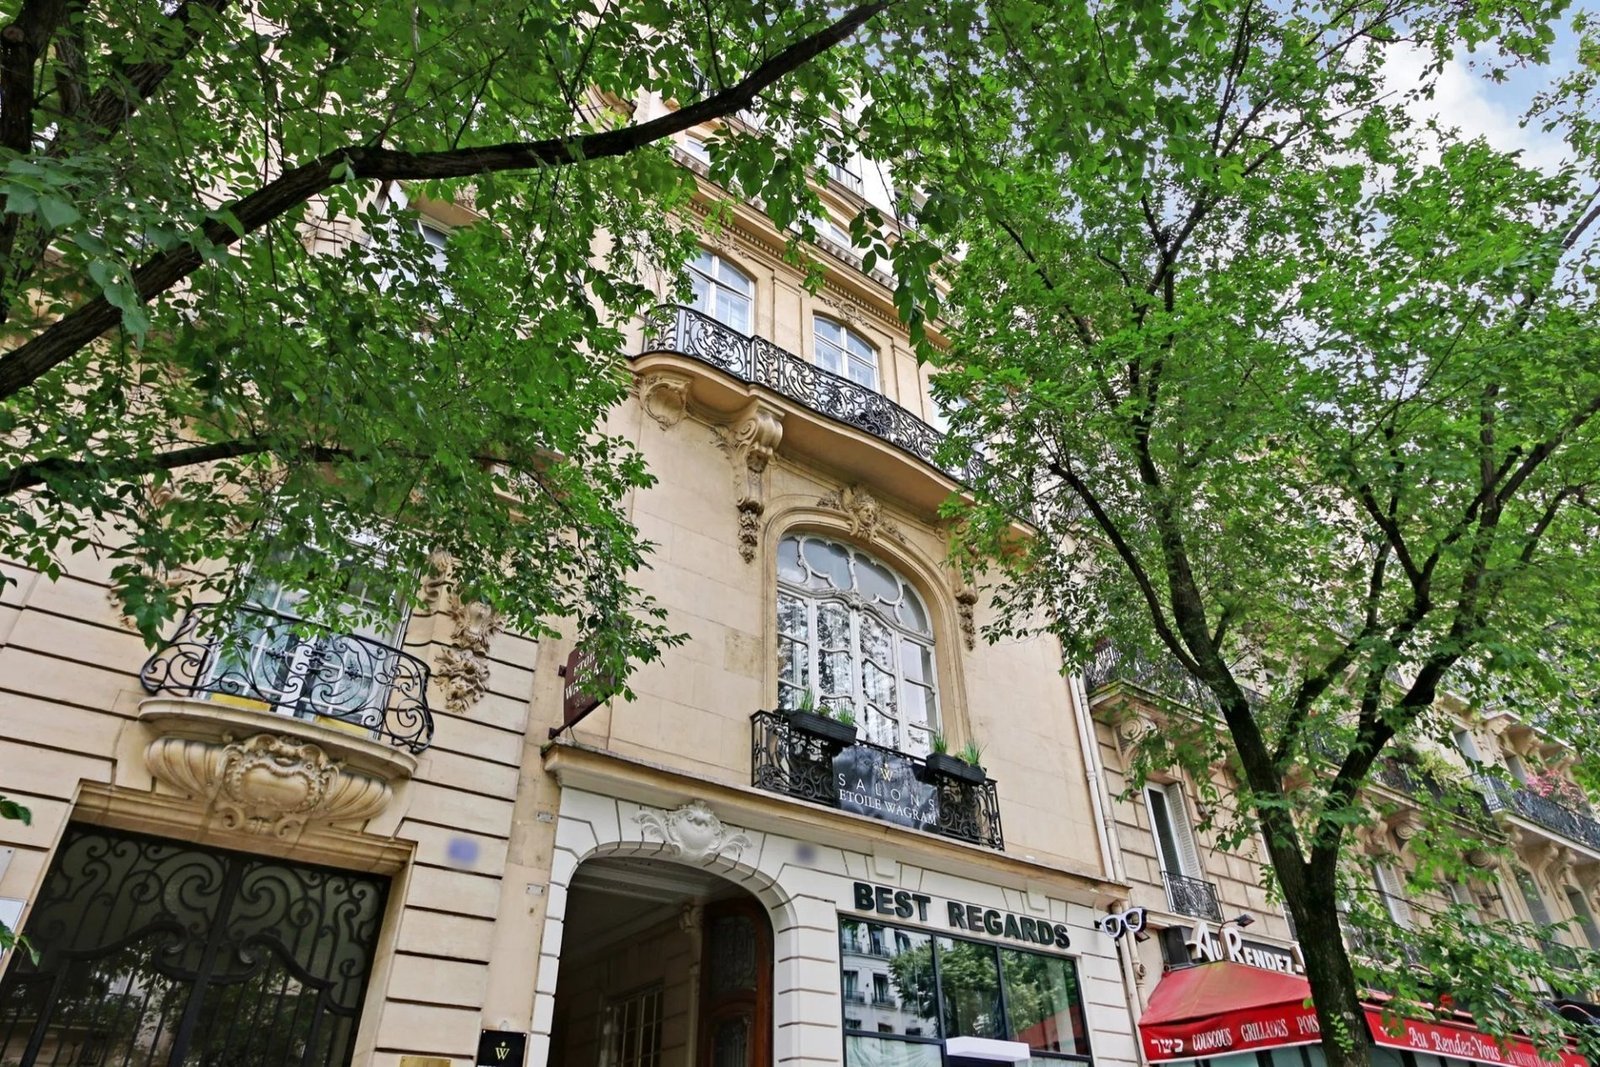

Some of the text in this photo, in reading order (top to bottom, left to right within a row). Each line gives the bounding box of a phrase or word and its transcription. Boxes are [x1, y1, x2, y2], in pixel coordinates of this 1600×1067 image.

[879, 767, 893, 782] W
[838, 773, 935, 811] SALONS
[839, 788, 937, 826] ETOILE WAGRAM
[853, 881, 1071, 949] BEST REGARDS
[1150, 1038, 1184, 1054] כשר
[1192, 1027, 1233, 1051] COUSCOUS
[1240, 1018, 1289, 1043] GRILLADES
[1408, 1026, 1429, 1049] Au
[1431, 1030, 1501, 1062] Rendez-Vous
[495, 1047, 510, 1060] W
